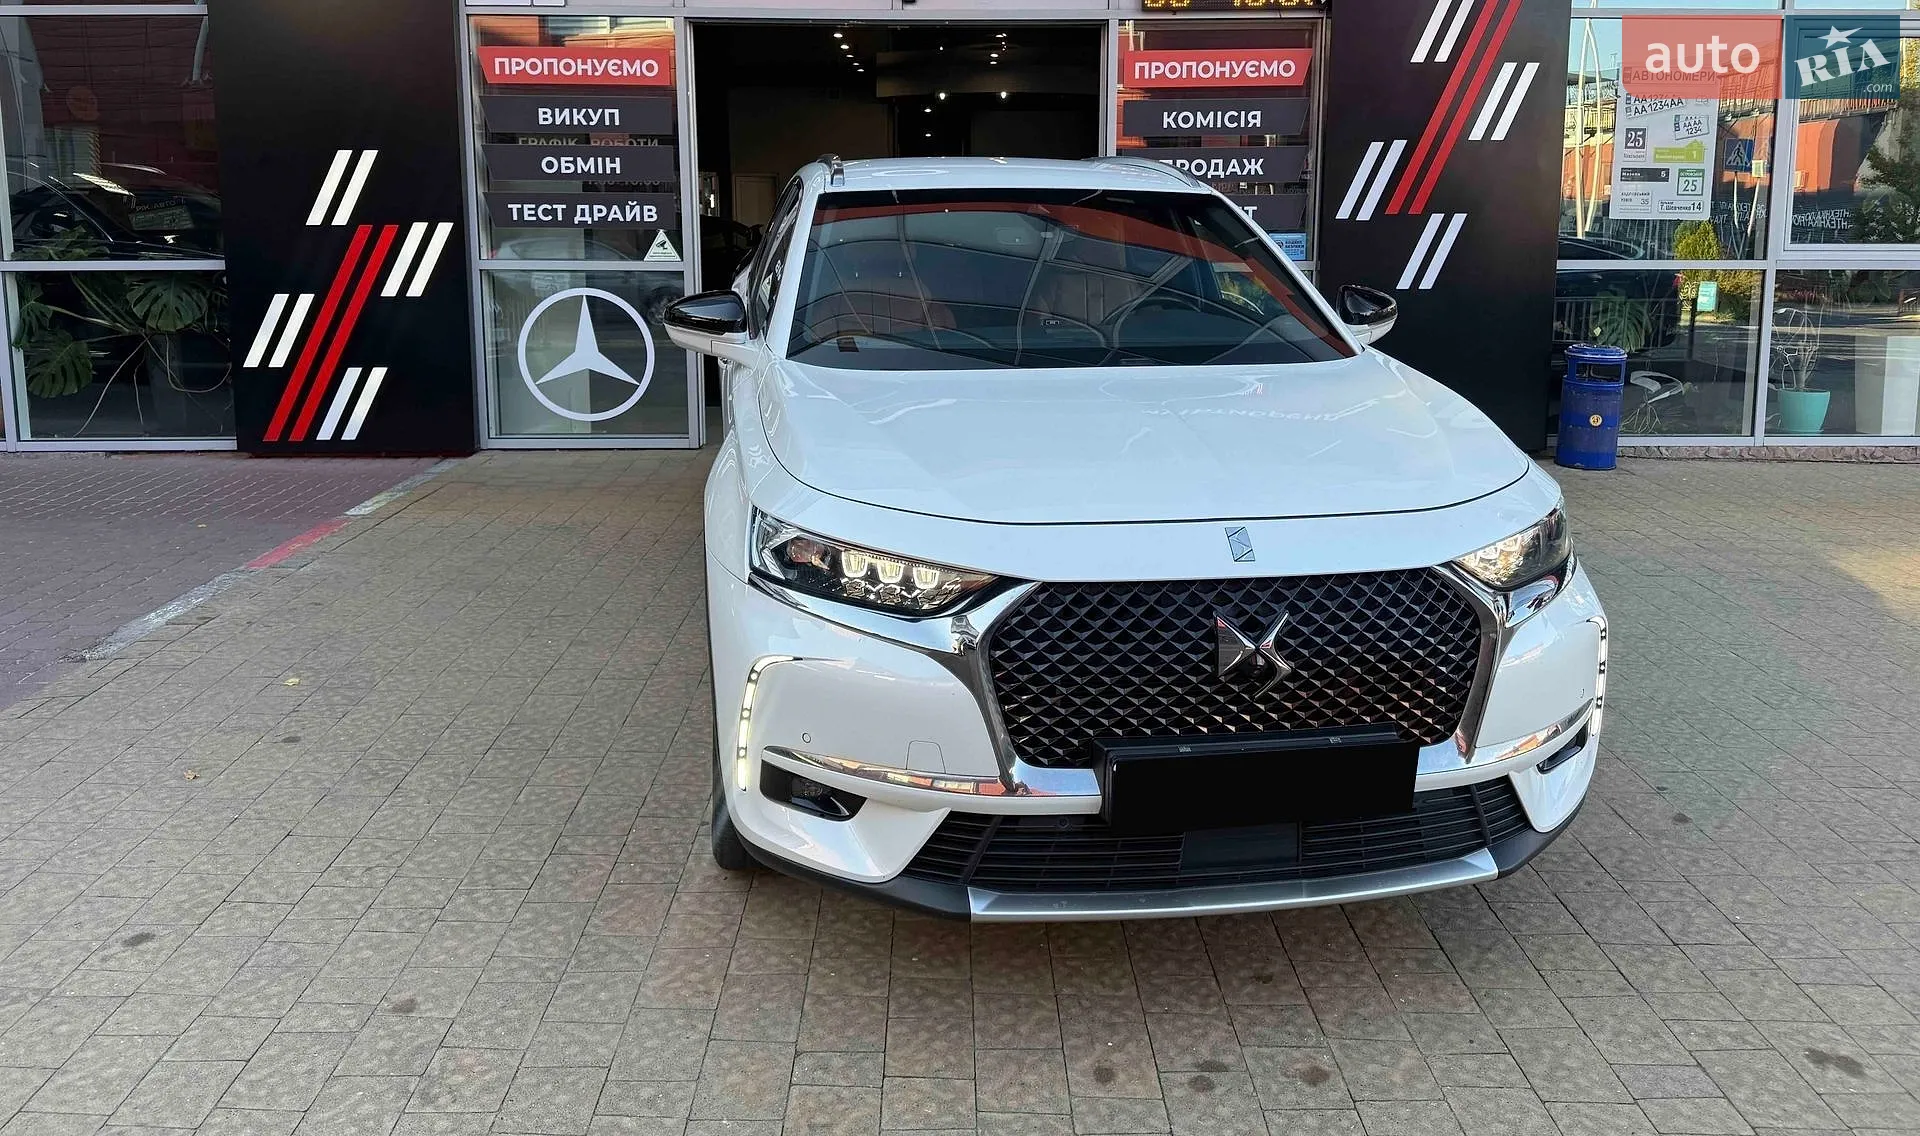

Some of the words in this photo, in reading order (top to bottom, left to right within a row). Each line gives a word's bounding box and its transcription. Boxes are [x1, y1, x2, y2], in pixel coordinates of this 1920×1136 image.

[495, 58, 659, 77] ПРОПОНУЄМО
[1134, 60, 1296, 79] ПРОПОНУЄМО
[538, 108, 620, 126] ВИКУП
[1163, 111, 1262, 128] КОМІСІЯ
[1627, 131, 1643, 147] 25
[541, 156, 621, 174] ОБМІН
[1682, 178, 1697, 192] 25
[508, 203, 567, 221] ТЕСТ
[574, 201, 658, 224] ДРАЙВ
[1691, 201, 1702, 211] 14
